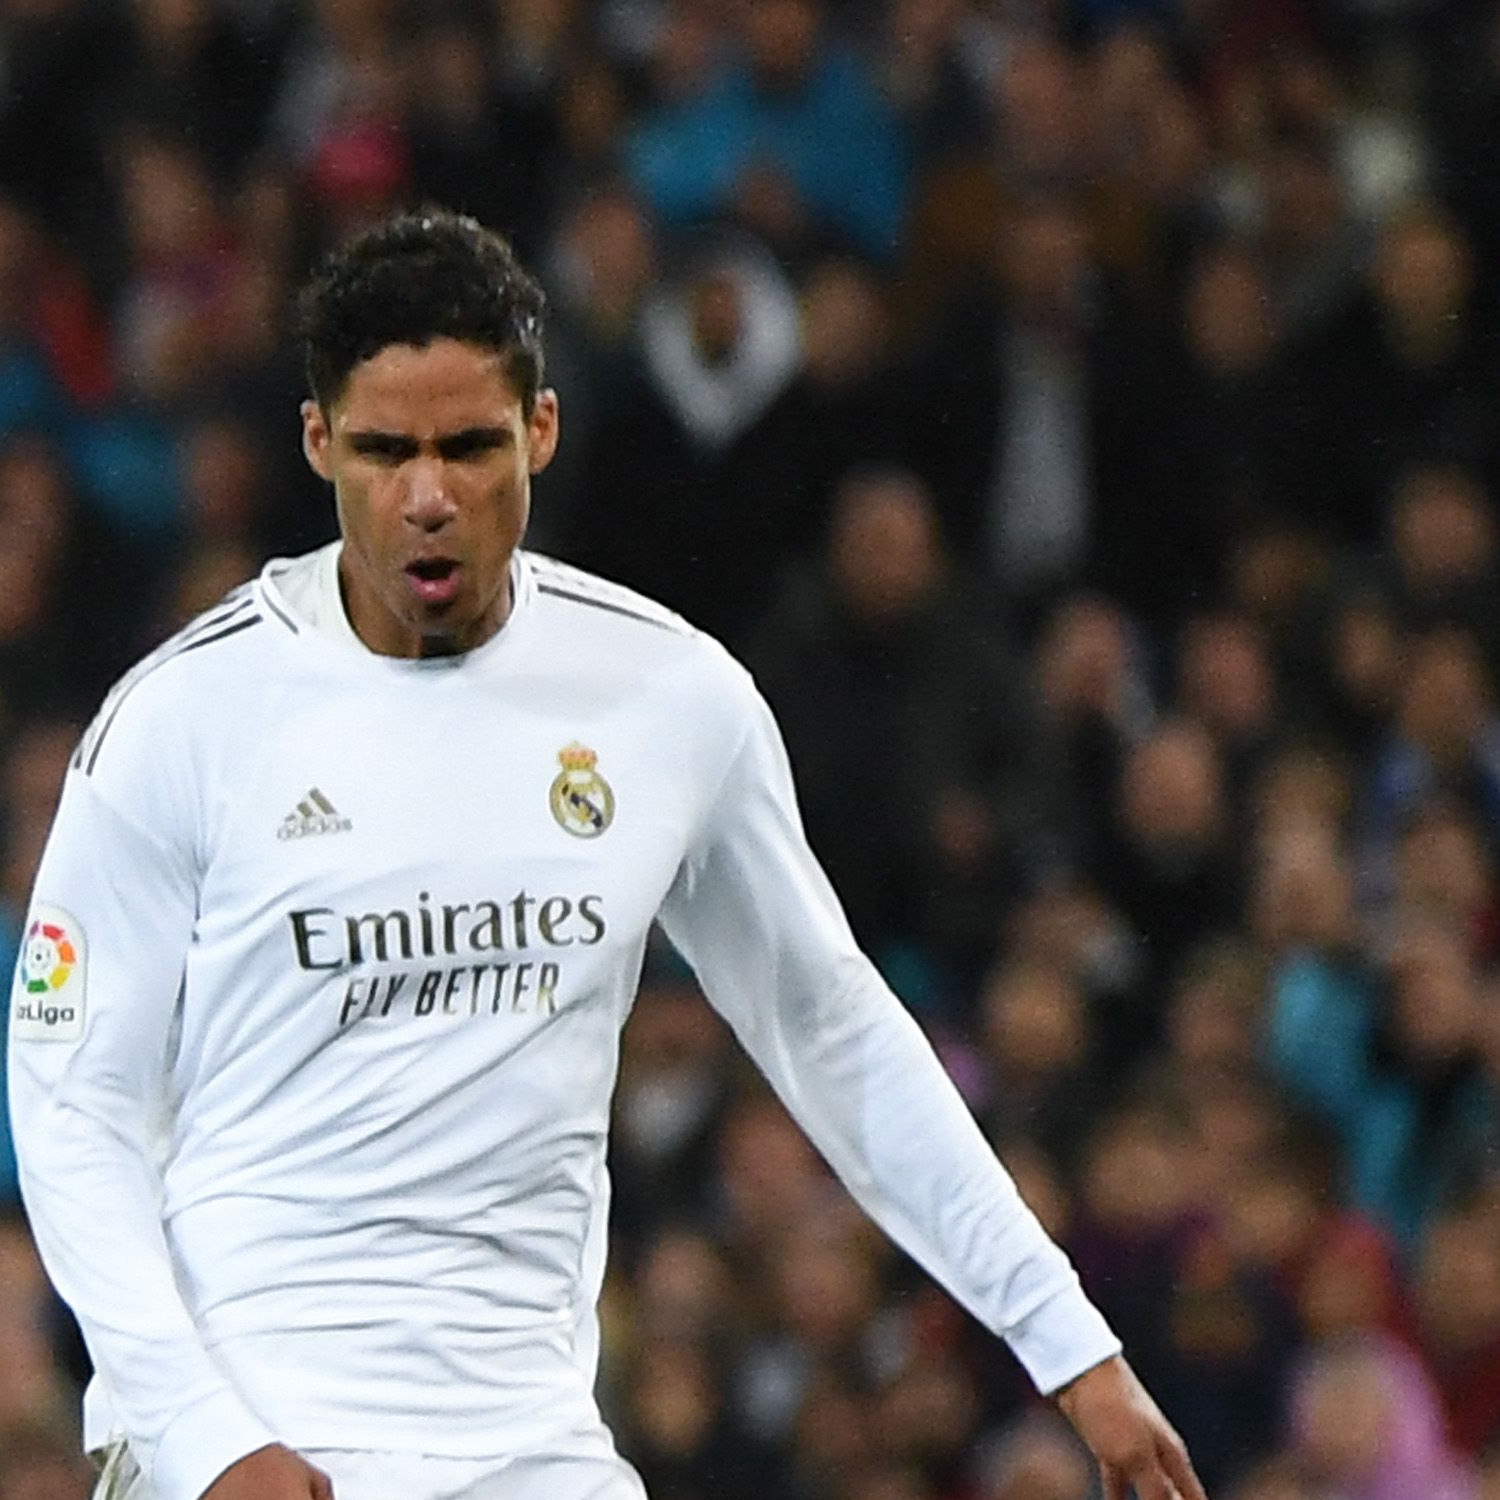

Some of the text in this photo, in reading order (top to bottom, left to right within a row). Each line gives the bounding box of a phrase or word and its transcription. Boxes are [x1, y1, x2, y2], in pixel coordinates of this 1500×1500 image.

[287, 889, 606, 970] Emirates
[339, 961, 560, 1026] FLY BETTER
